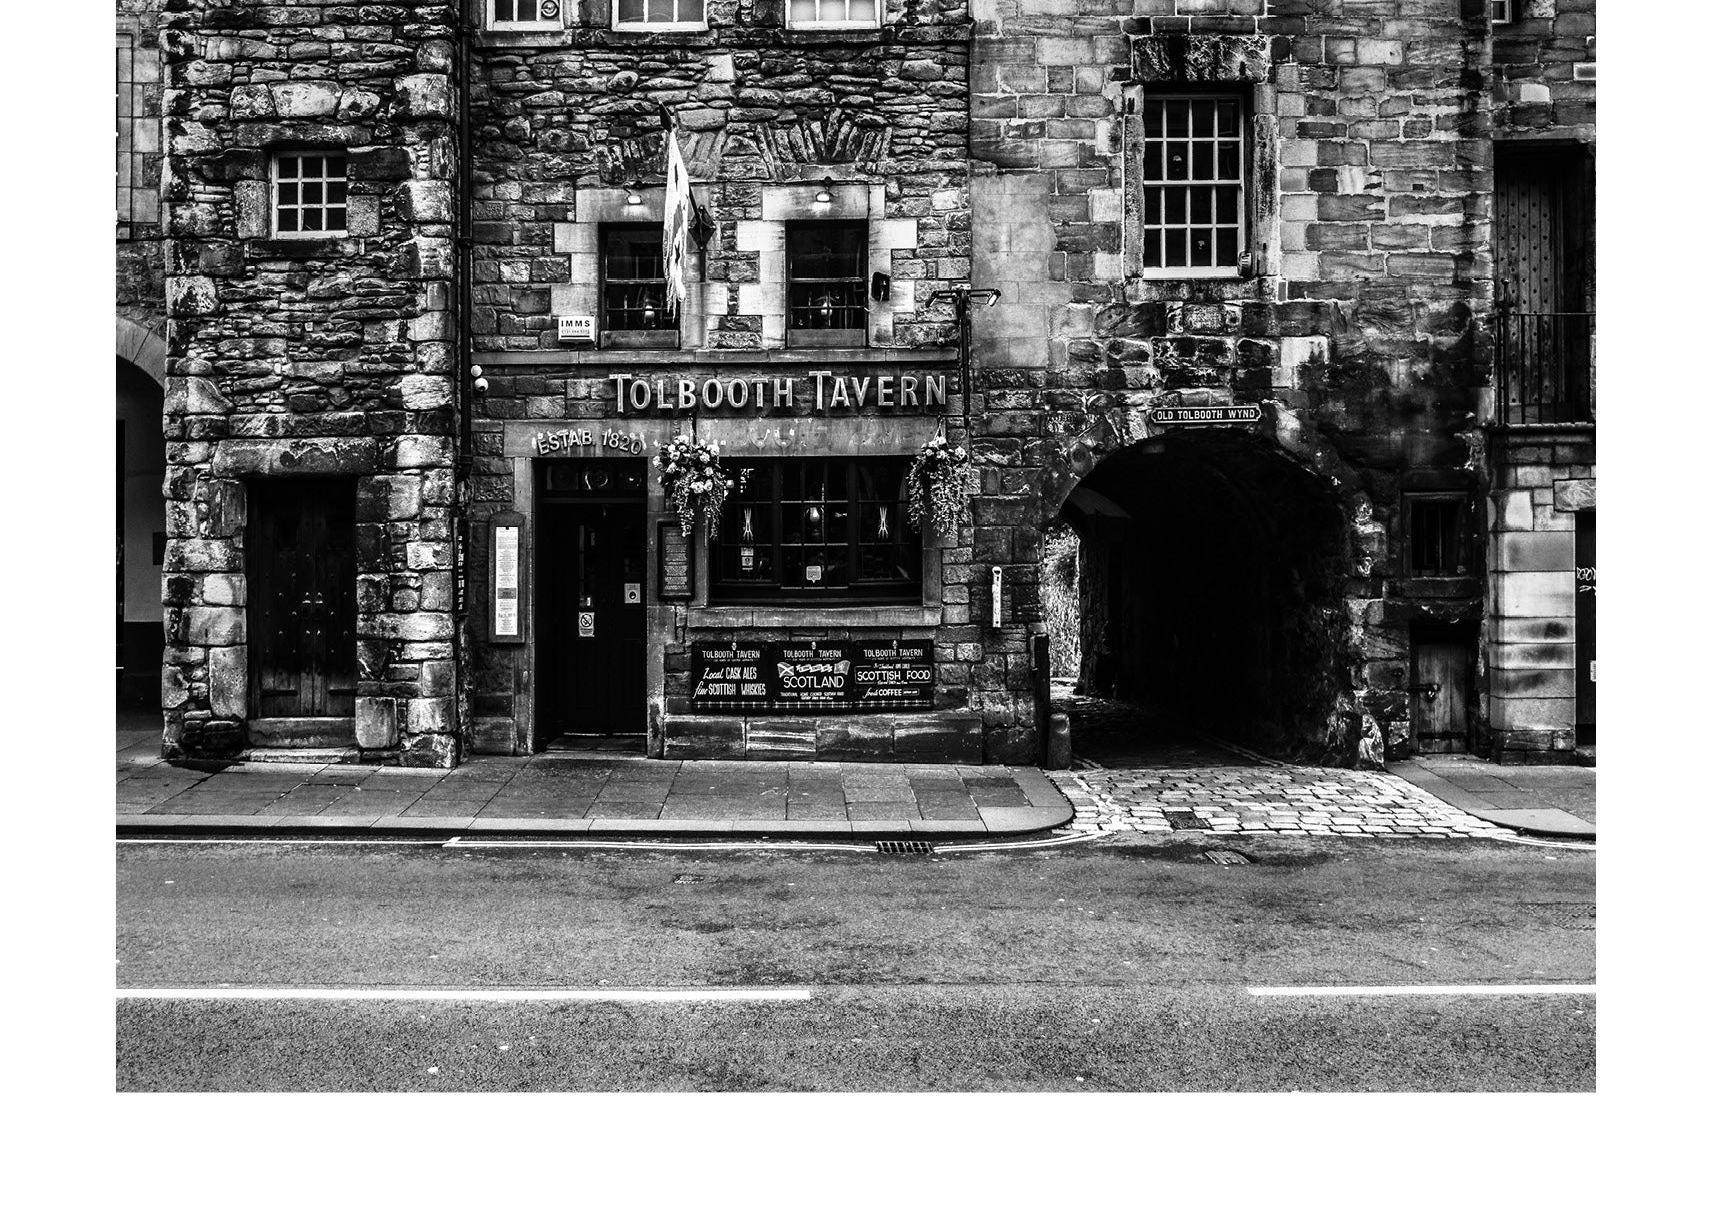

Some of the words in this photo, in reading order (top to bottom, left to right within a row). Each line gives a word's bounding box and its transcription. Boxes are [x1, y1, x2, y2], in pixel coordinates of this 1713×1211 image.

[609, 373, 793, 413] TOLBOOTH
[808, 370, 946, 410] TAVERN
[1157, 410, 1174, 420] OLD
[1177, 410, 1223, 420] TOLBOOTH
[1228, 409, 1255, 419] WYND
[537, 429, 596, 455] ESTAB.
[601, 430, 643, 455] 1820
[702, 650, 734, 659] TOLBOOTH
[736, 650, 761, 659] TAVERN
[783, 650, 814, 658] TOLBOOTH
[818, 650, 842, 658] TAVERN
[863, 649, 897, 657] TOLBOOTH
[899, 648, 923, 657] TAVERN
[703, 667, 724, 680] Local
[725, 666, 741, 679] CASK
[742, 666, 757, 679] ALES
[857, 670, 901, 681] SCOTTISH
[906, 670, 931, 680] FOOD
[783, 675, 844, 689] SCOTLAND
[692, 680, 708, 699] fine
[708, 683, 737, 696] SCOTTISH
[740, 683, 766, 696] WHISKIES
[878, 688, 902, 696] COFFEE
